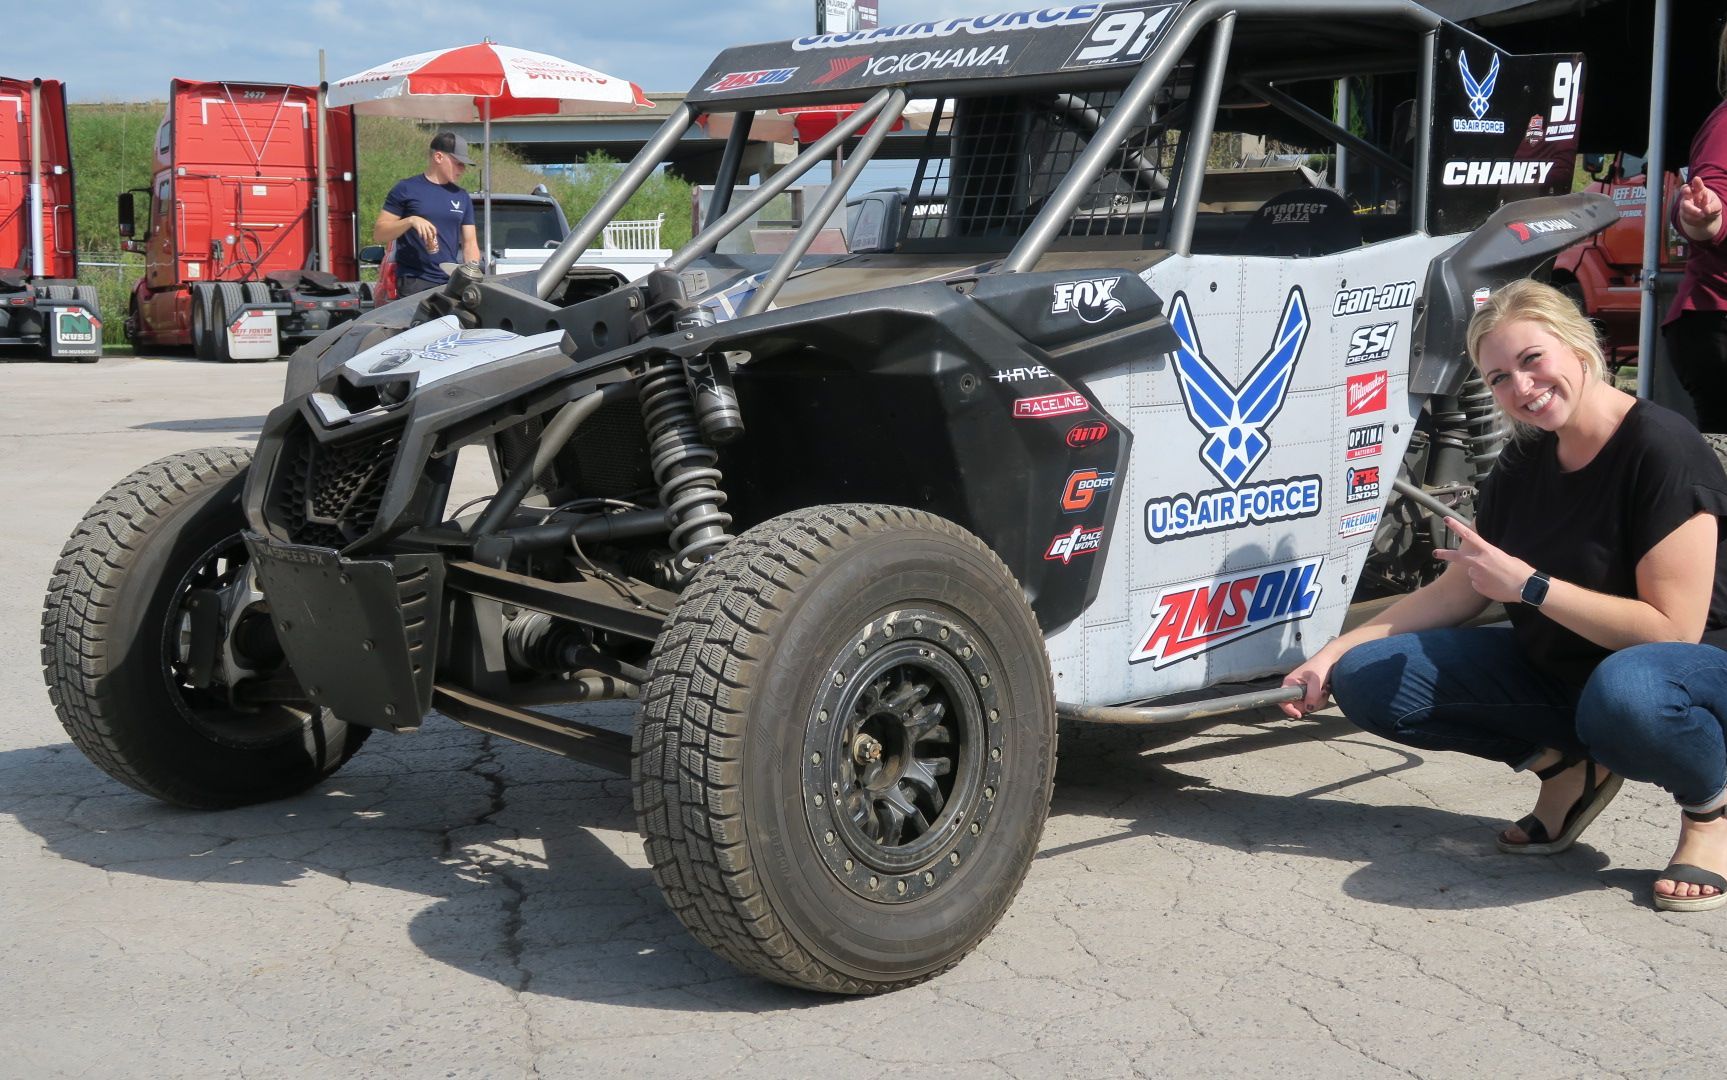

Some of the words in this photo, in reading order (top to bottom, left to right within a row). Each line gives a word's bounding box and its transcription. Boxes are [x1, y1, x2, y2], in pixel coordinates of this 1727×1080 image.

[1076, 7, 1172, 60] 91
[861, 45, 1009, 77] YOKOHAMA
[704, 67, 800, 93] AMSOIL
[1550, 62, 1582, 122] 91
[1481, 121, 1504, 133] FORCE
[1443, 162, 1554, 185] CHANEY
[1263, 203, 1328, 217] PYROTECT
[1273, 213, 1309, 222] BAJA
[1052, 276, 1126, 322] FOX
[1333, 281, 1416, 317] can-am
[61, 333, 91, 341] NUSS
[1348, 323, 1397, 356] SSI
[1347, 351, 1389, 364] DECALS
[1348, 373, 1386, 405] Milwaukee
[1020, 395, 1084, 413] RACELINE
[1349, 426, 1383, 448] OPTIMA
[1354, 447, 1376, 457] BATTERIES
[1078, 477, 1115, 490] BOOST
[1354, 482, 1379, 493] ROD
[1240, 484, 1316, 518] FORCE
[1347, 490, 1379, 501] ENDS
[1341, 512, 1378, 530] FREEDOM
[1074, 540, 1100, 551] WORX
[1079, 531, 1102, 542] RACE
[1136, 561, 1320, 662] AMSOIL
